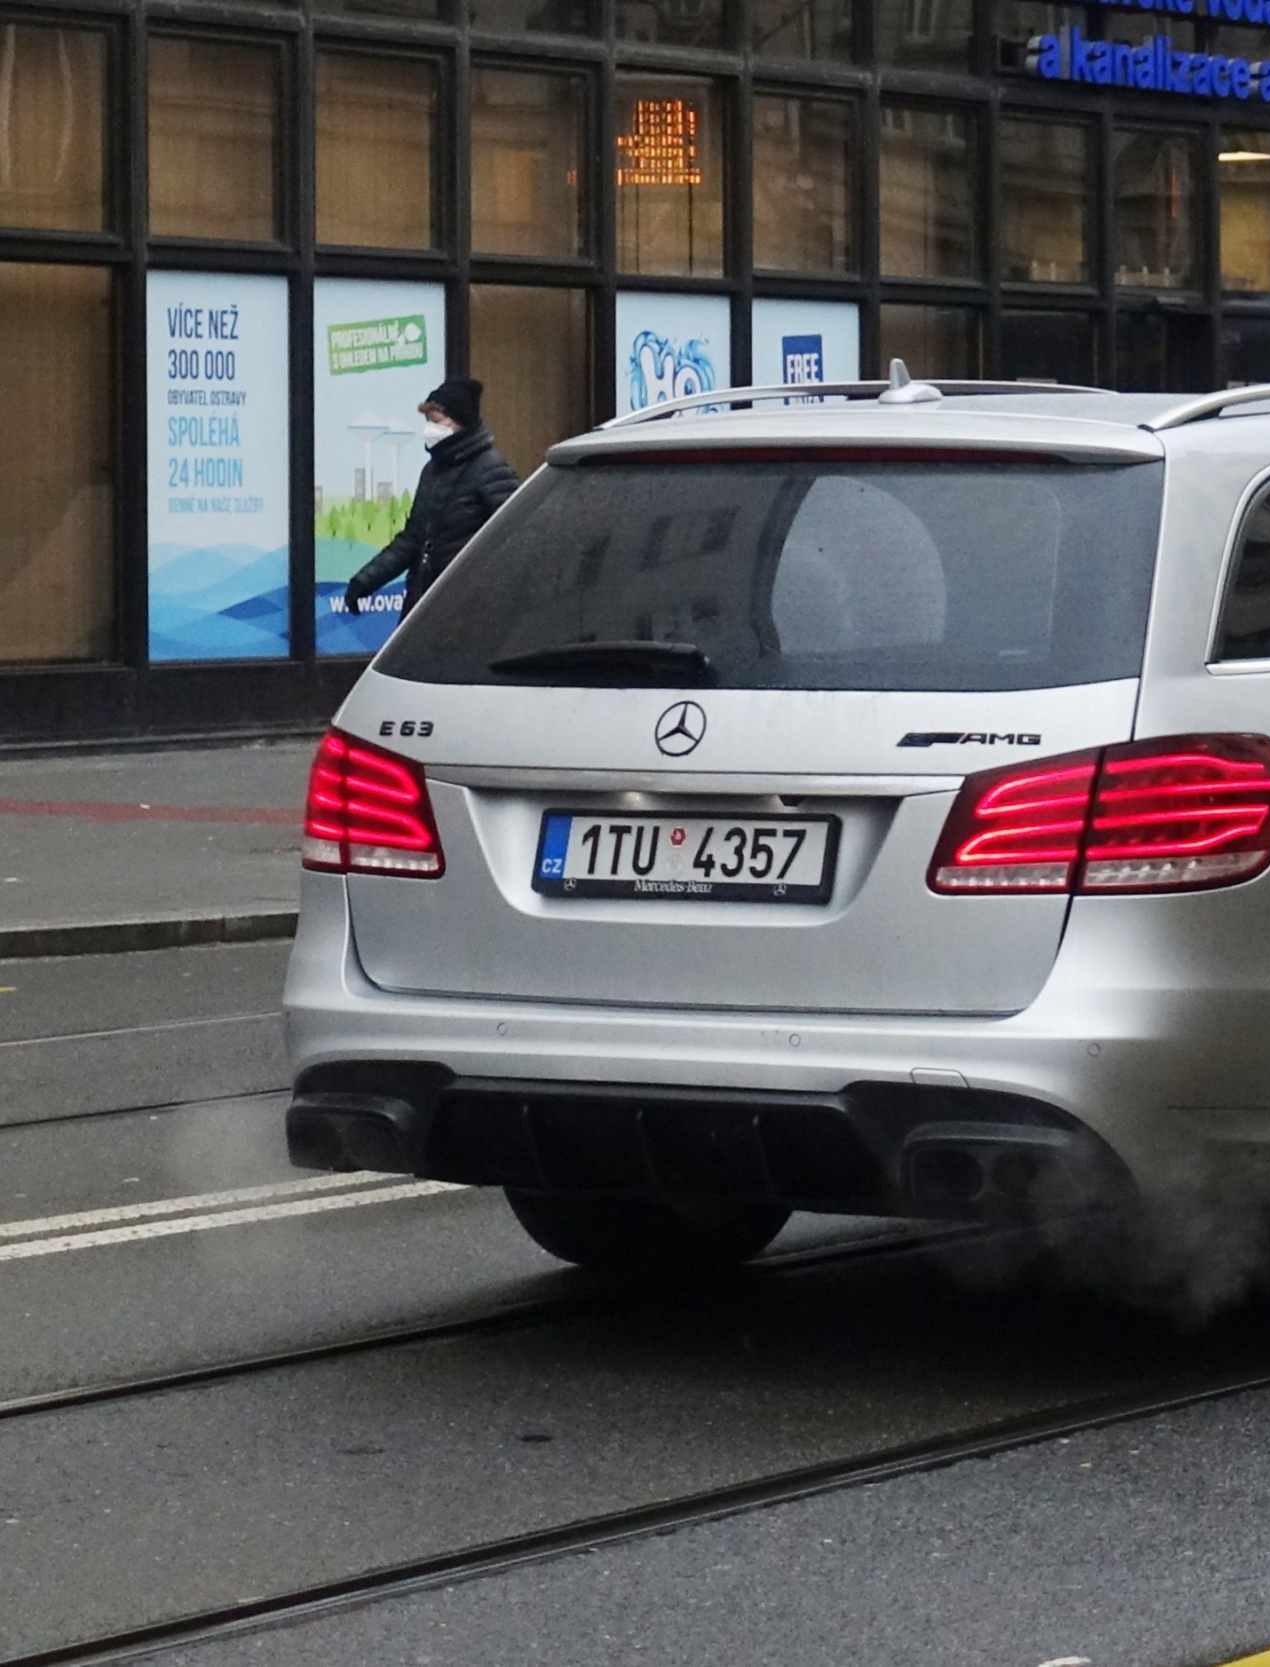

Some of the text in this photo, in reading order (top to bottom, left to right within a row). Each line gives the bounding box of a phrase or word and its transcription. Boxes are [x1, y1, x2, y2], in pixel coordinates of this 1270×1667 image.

[1037, 33, 1061, 79] a
[1068, 24, 1250, 100] kanalizace
[167, 302, 239, 340] VÍCE NEŽ
[168, 348, 235, 381] 300 000
[786, 352, 820, 385] FREE
[168, 411, 240, 447] SPOLÉHÁ
[168, 457, 243, 488] 24 HODIN
[379, 720, 434, 738] E 63
[959, 732, 1042, 746] AMG
[541, 858, 563, 874] CZ
[582, 824, 807, 880] 1TU 4357
[634, 879, 713, 894] Mercedes-Benz
